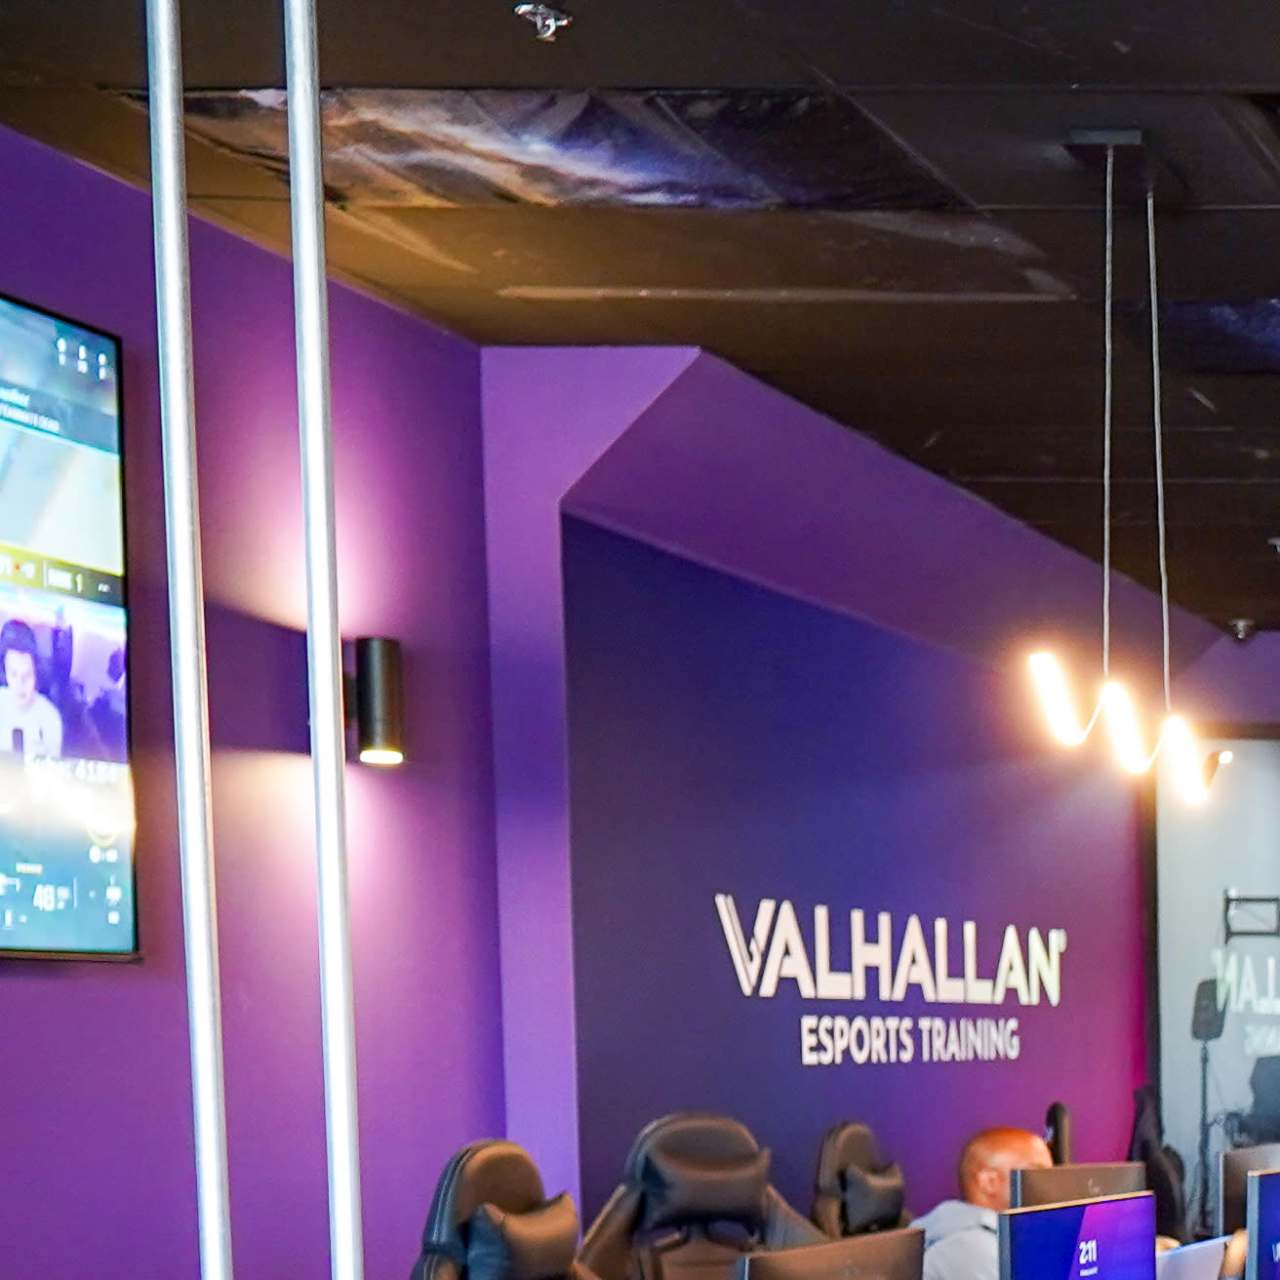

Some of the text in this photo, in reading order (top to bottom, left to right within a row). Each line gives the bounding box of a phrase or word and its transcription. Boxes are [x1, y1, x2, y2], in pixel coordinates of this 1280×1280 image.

[714, 892, 1063, 1007] VALHALLAN
[800, 1014, 1021, 1066] ESPORTS TRAINING
